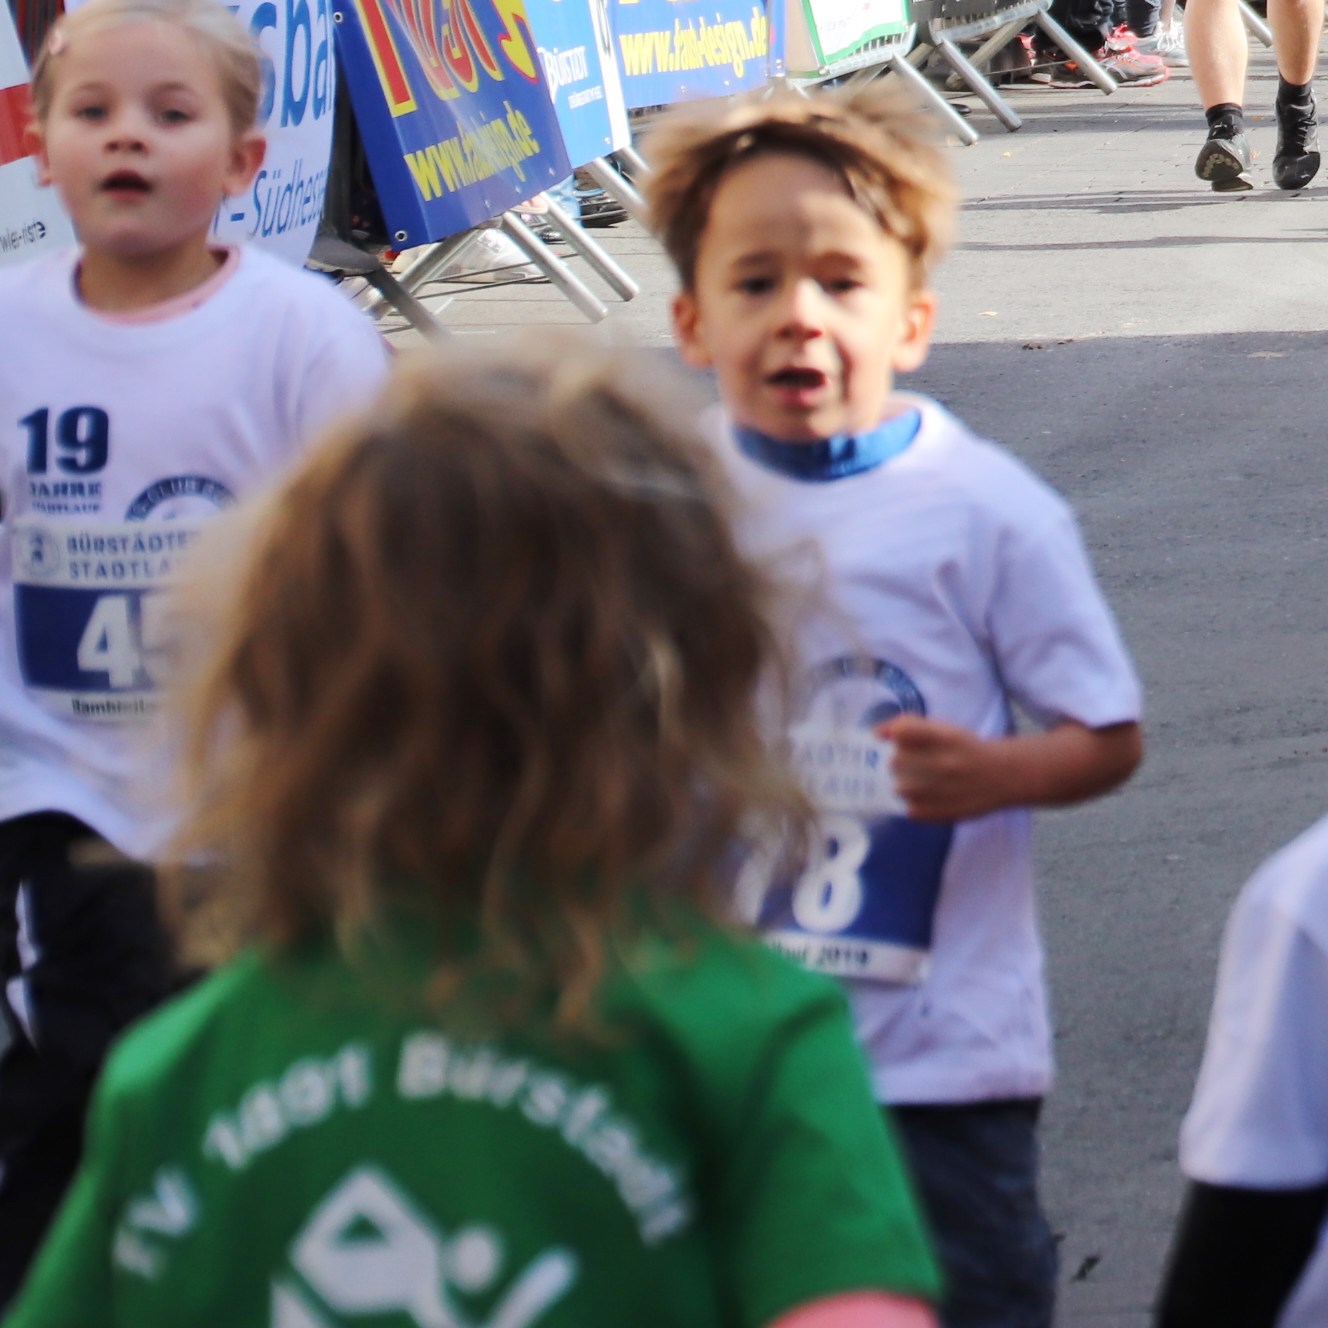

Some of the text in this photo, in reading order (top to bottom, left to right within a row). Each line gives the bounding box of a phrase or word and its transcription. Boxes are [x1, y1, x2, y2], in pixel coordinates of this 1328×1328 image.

[17, 405, 110, 476] 19
[67, 528, 192, 556] BÜRSTÄDTE
[69, 559, 172, 581] STADTLA
